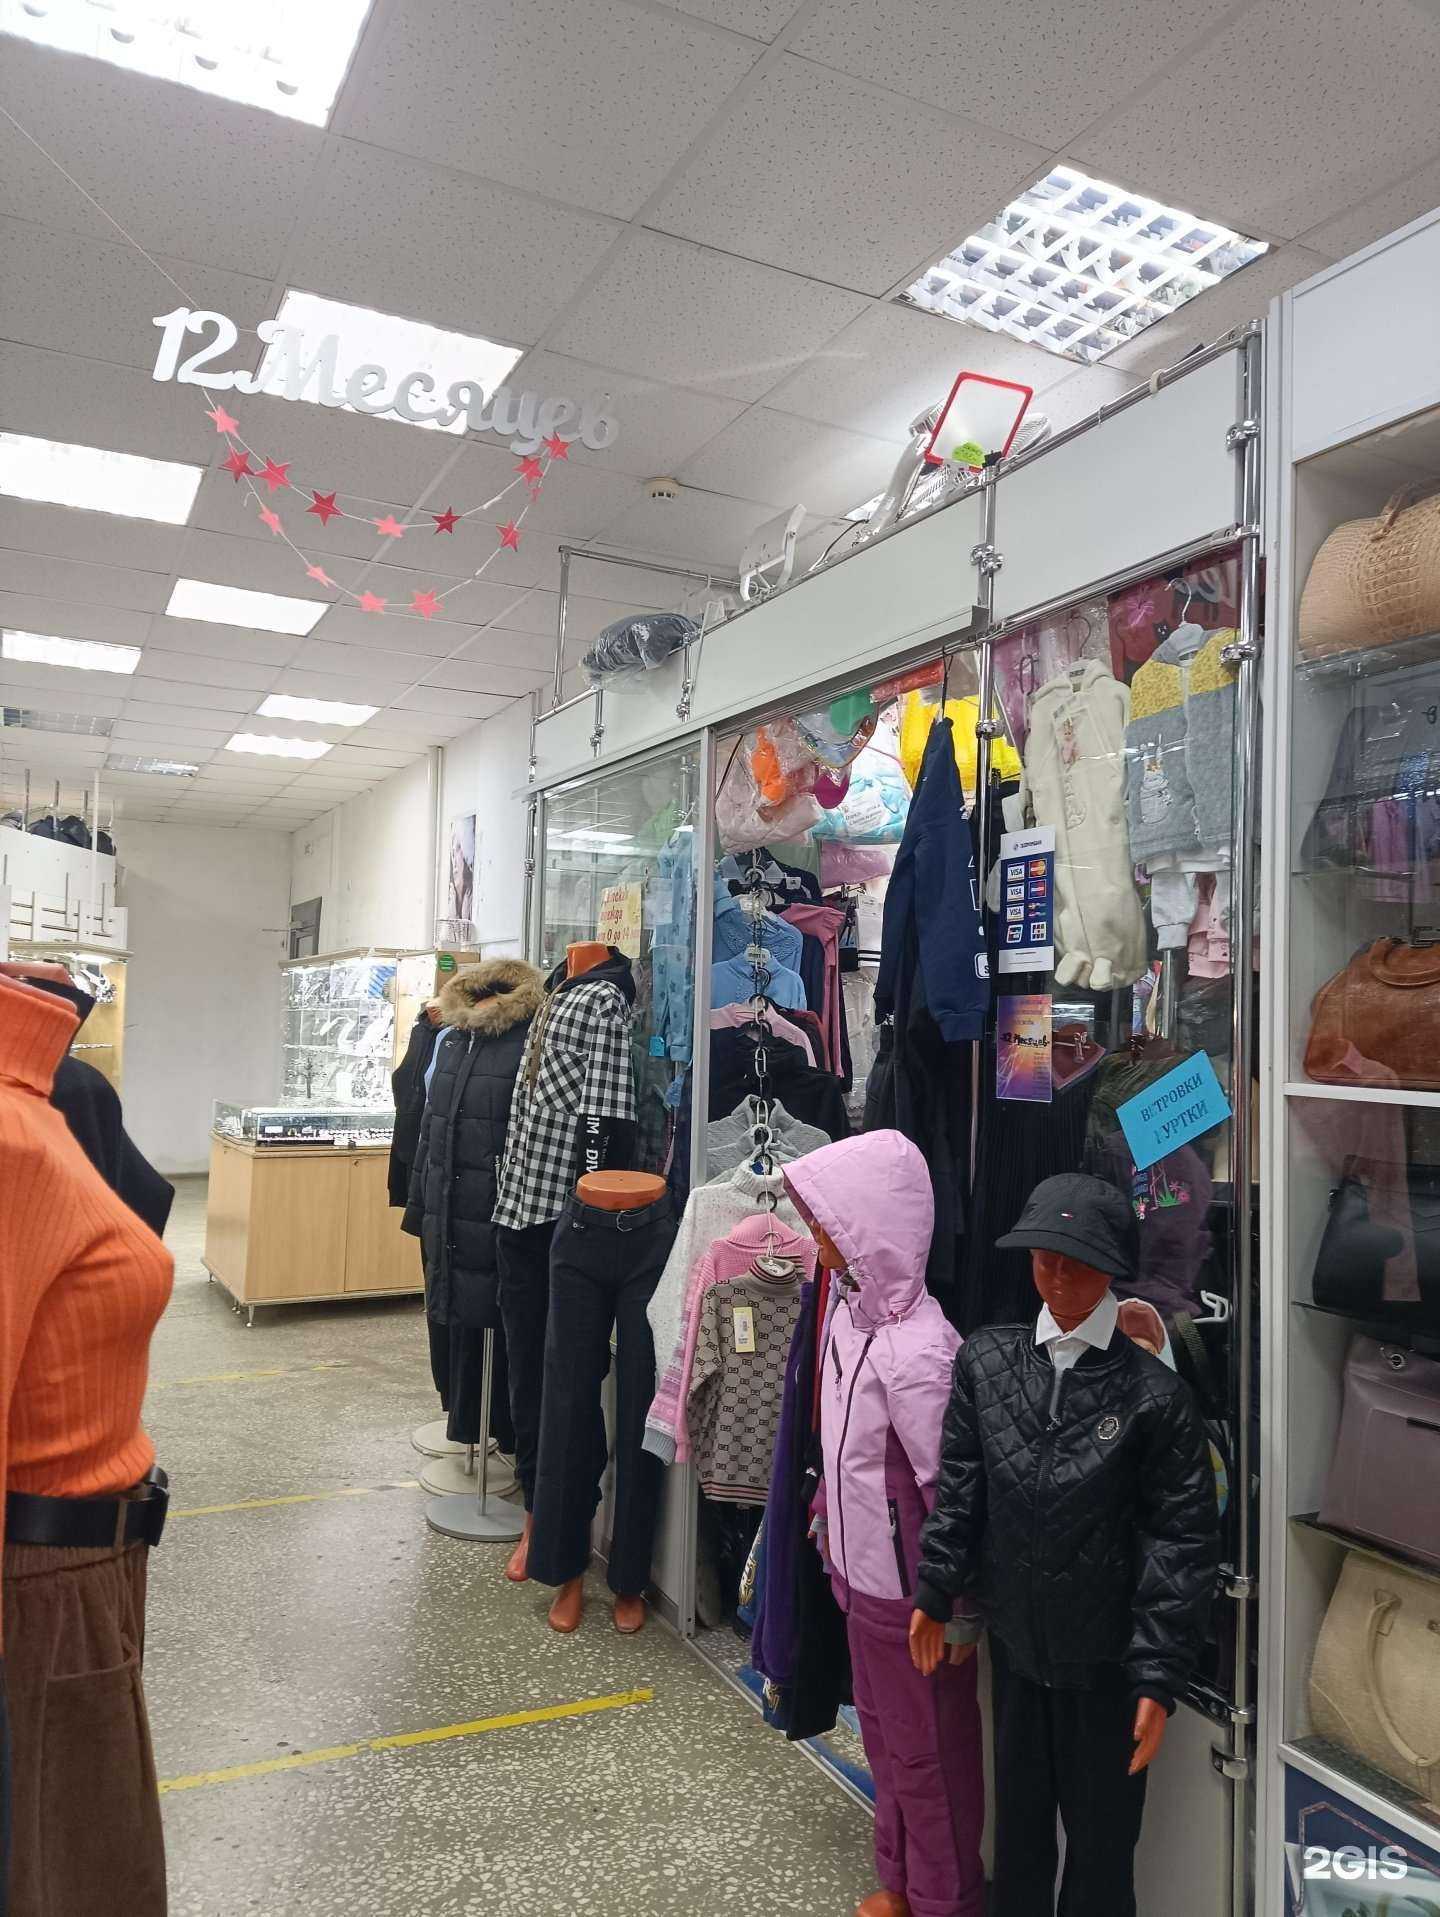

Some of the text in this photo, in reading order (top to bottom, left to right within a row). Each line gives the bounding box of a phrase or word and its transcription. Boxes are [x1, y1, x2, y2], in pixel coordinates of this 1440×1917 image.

[152, 307, 619, 456] 12 Месяцев
[1010, 868, 1023, 876] VISA
[1010, 888, 1022, 896] VISA
[1009, 908, 1021, 916] VISA
